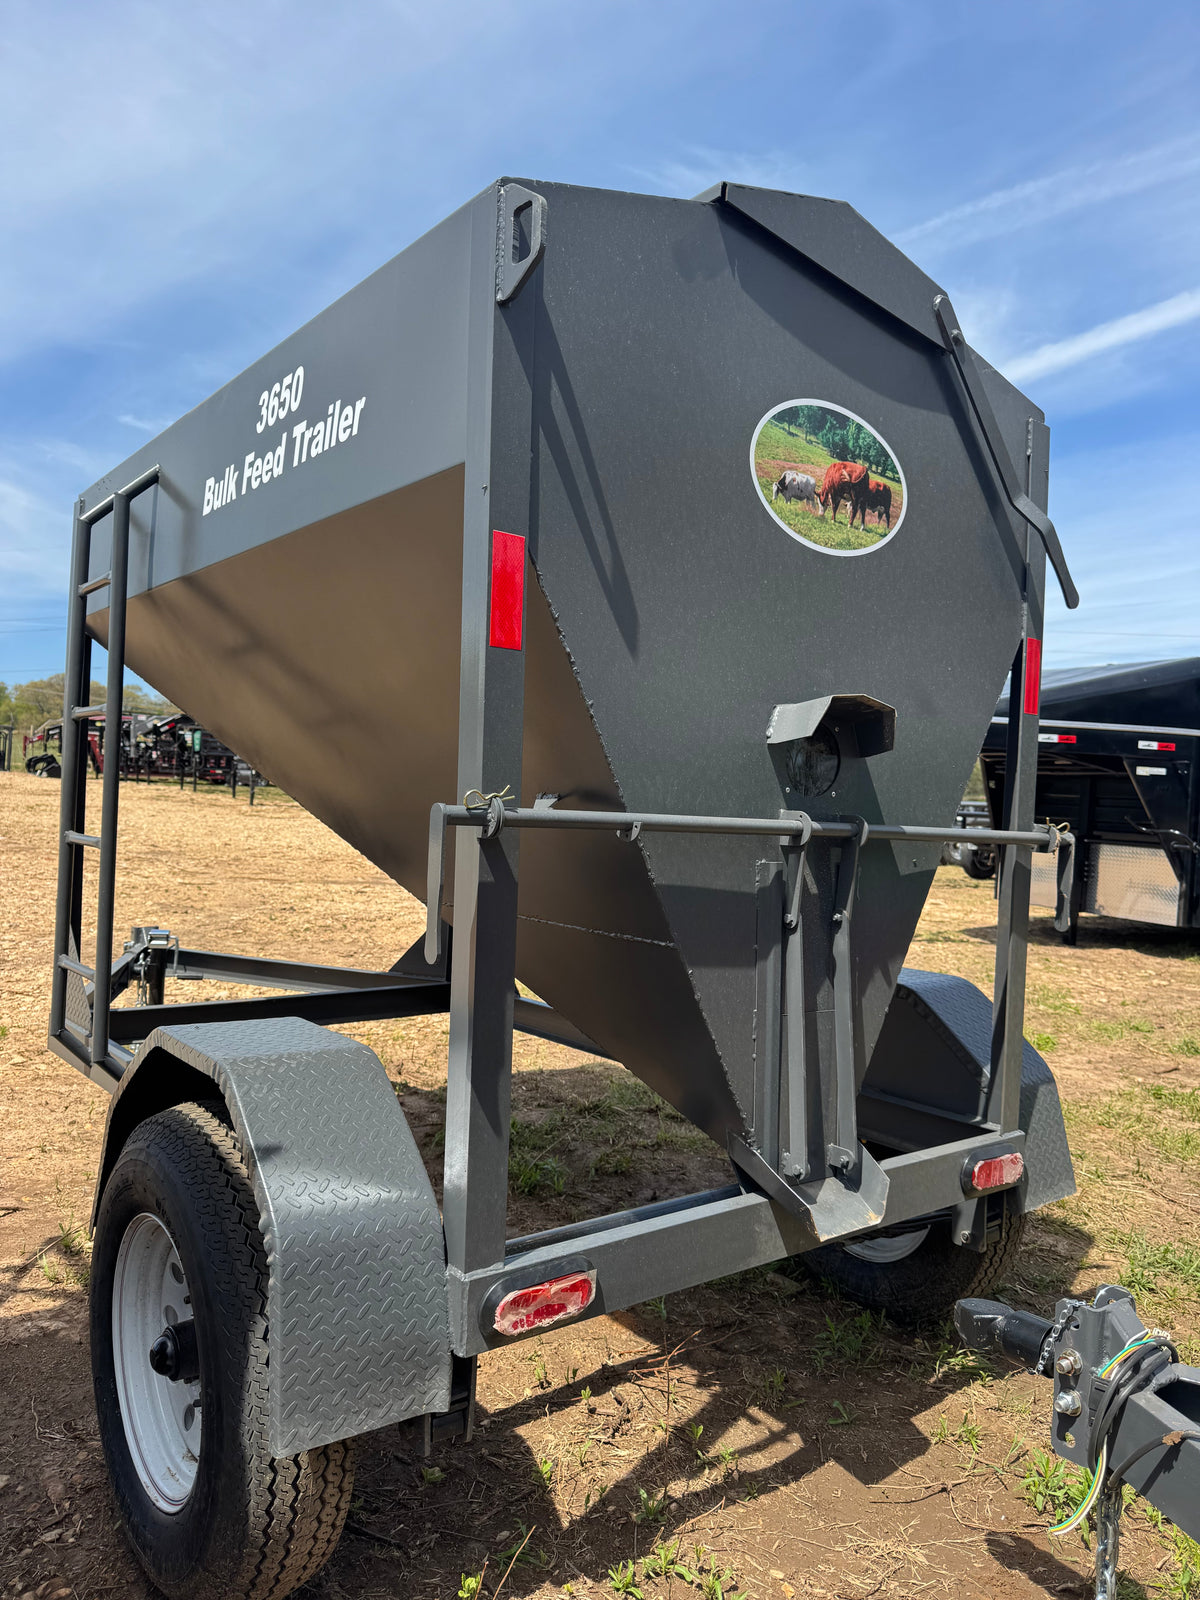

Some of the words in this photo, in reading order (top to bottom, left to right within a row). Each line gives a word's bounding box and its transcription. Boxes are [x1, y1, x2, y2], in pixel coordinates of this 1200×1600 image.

[256, 365, 305, 434] 3650
[202, 463, 239, 517] Bulk
[241, 431, 288, 496] Feed
[292, 396, 367, 468] Trailer
